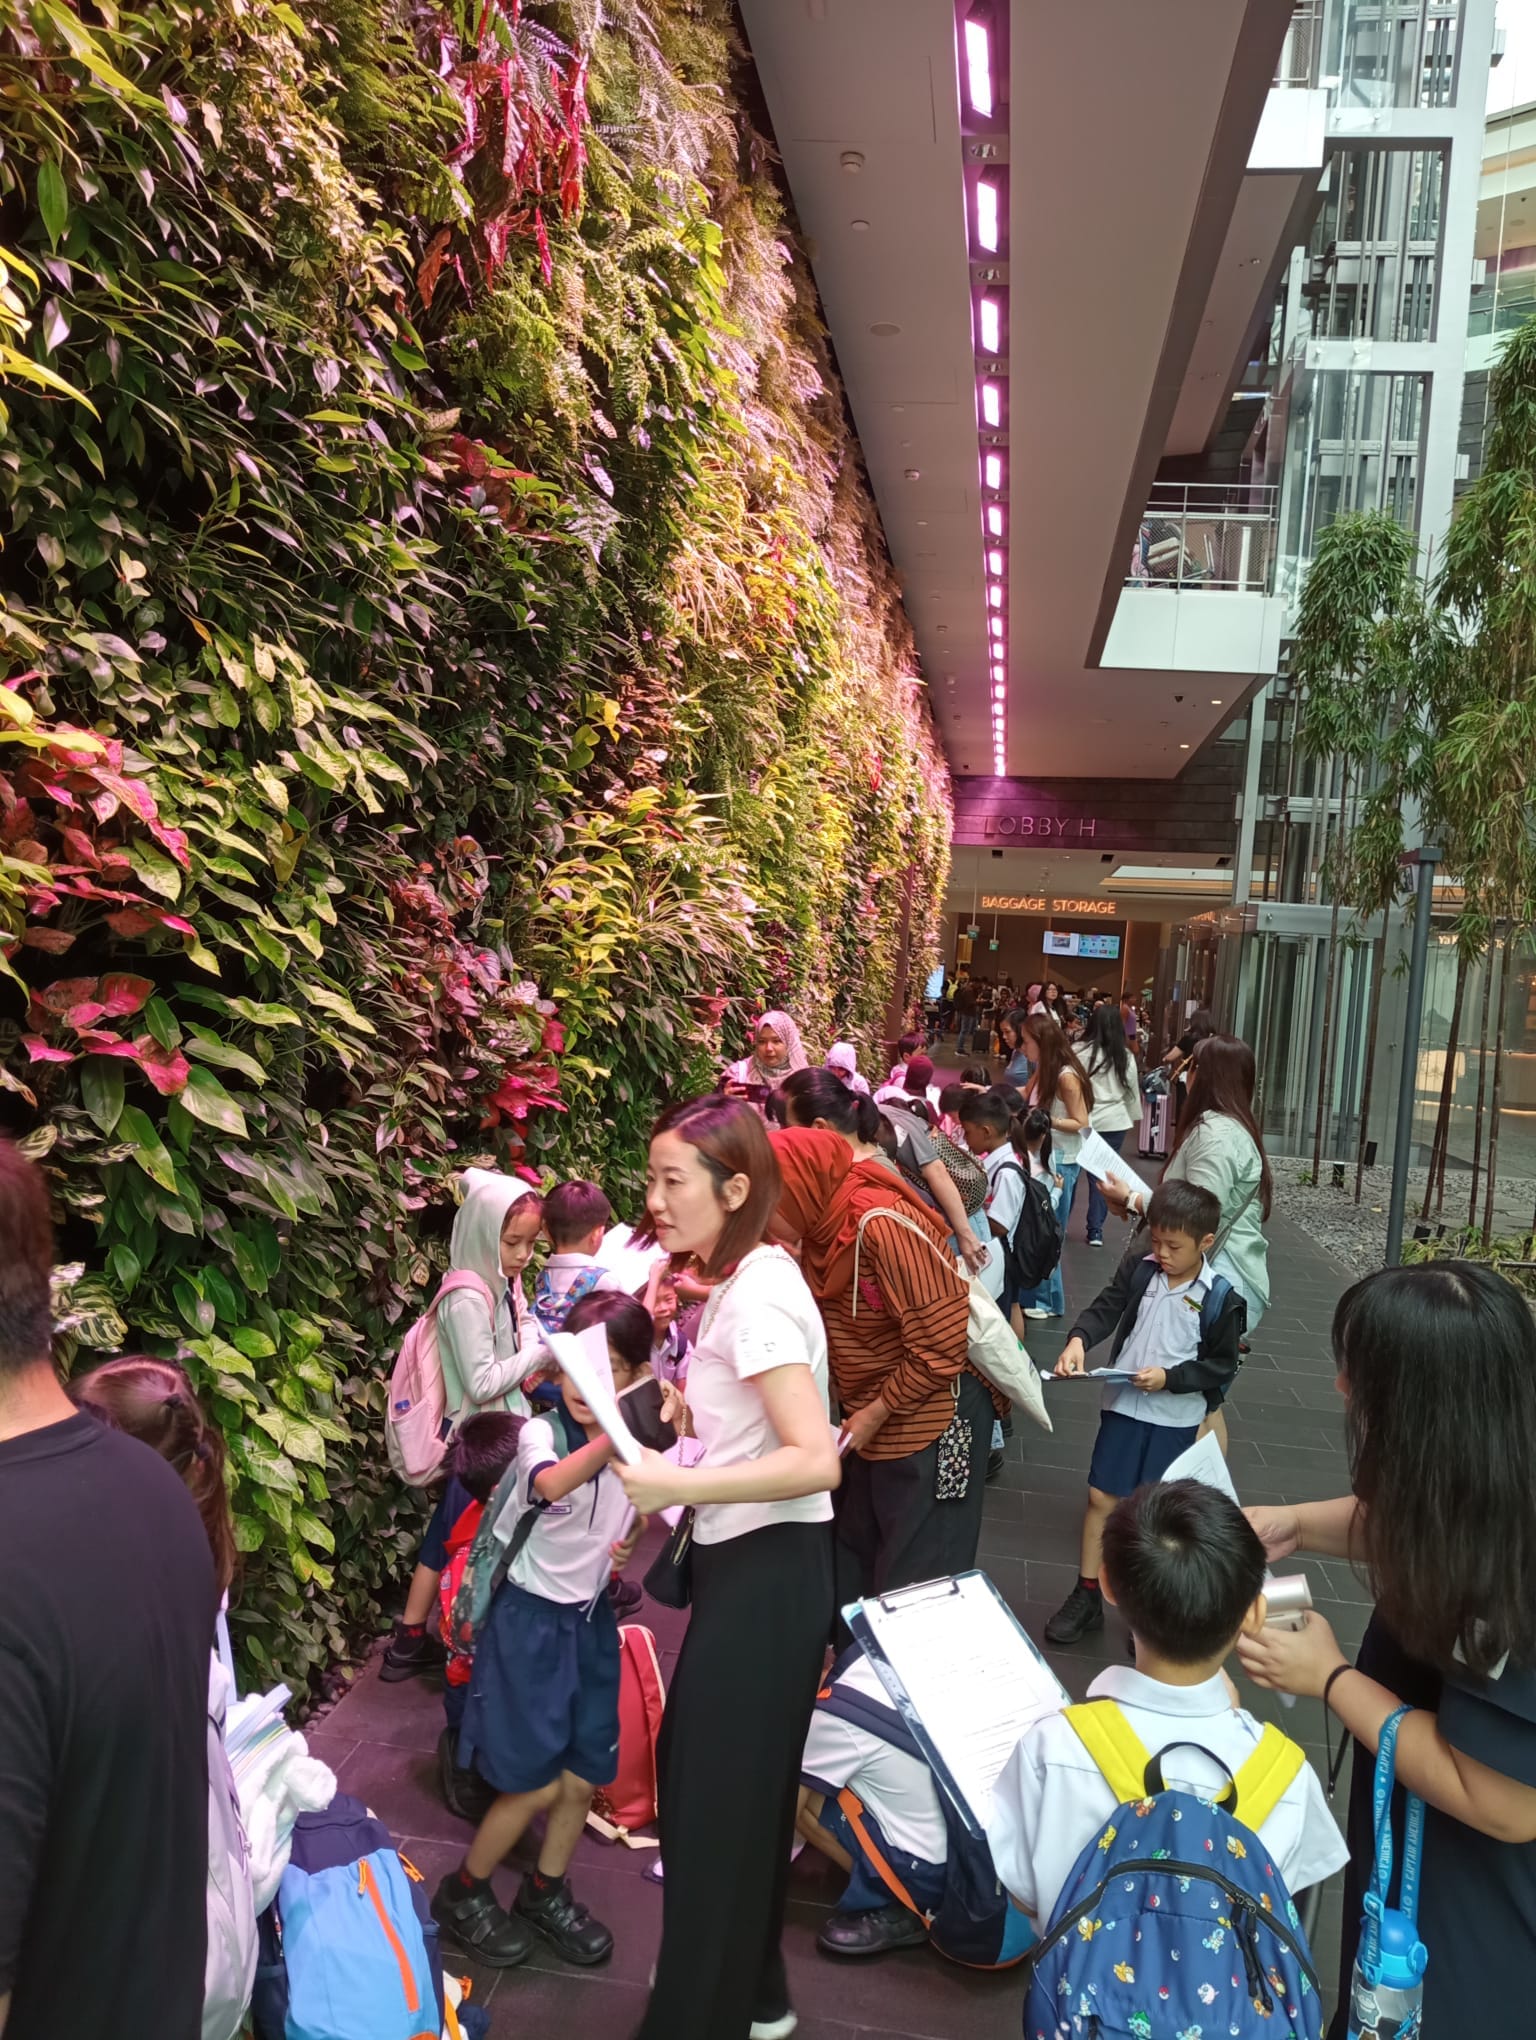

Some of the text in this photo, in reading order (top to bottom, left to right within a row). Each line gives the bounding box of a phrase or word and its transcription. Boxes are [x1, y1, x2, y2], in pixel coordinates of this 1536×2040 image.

[983, 815, 1096, 838] LOBBY H
[981, 896, 1117, 914] BAGGAGE STORAGE
